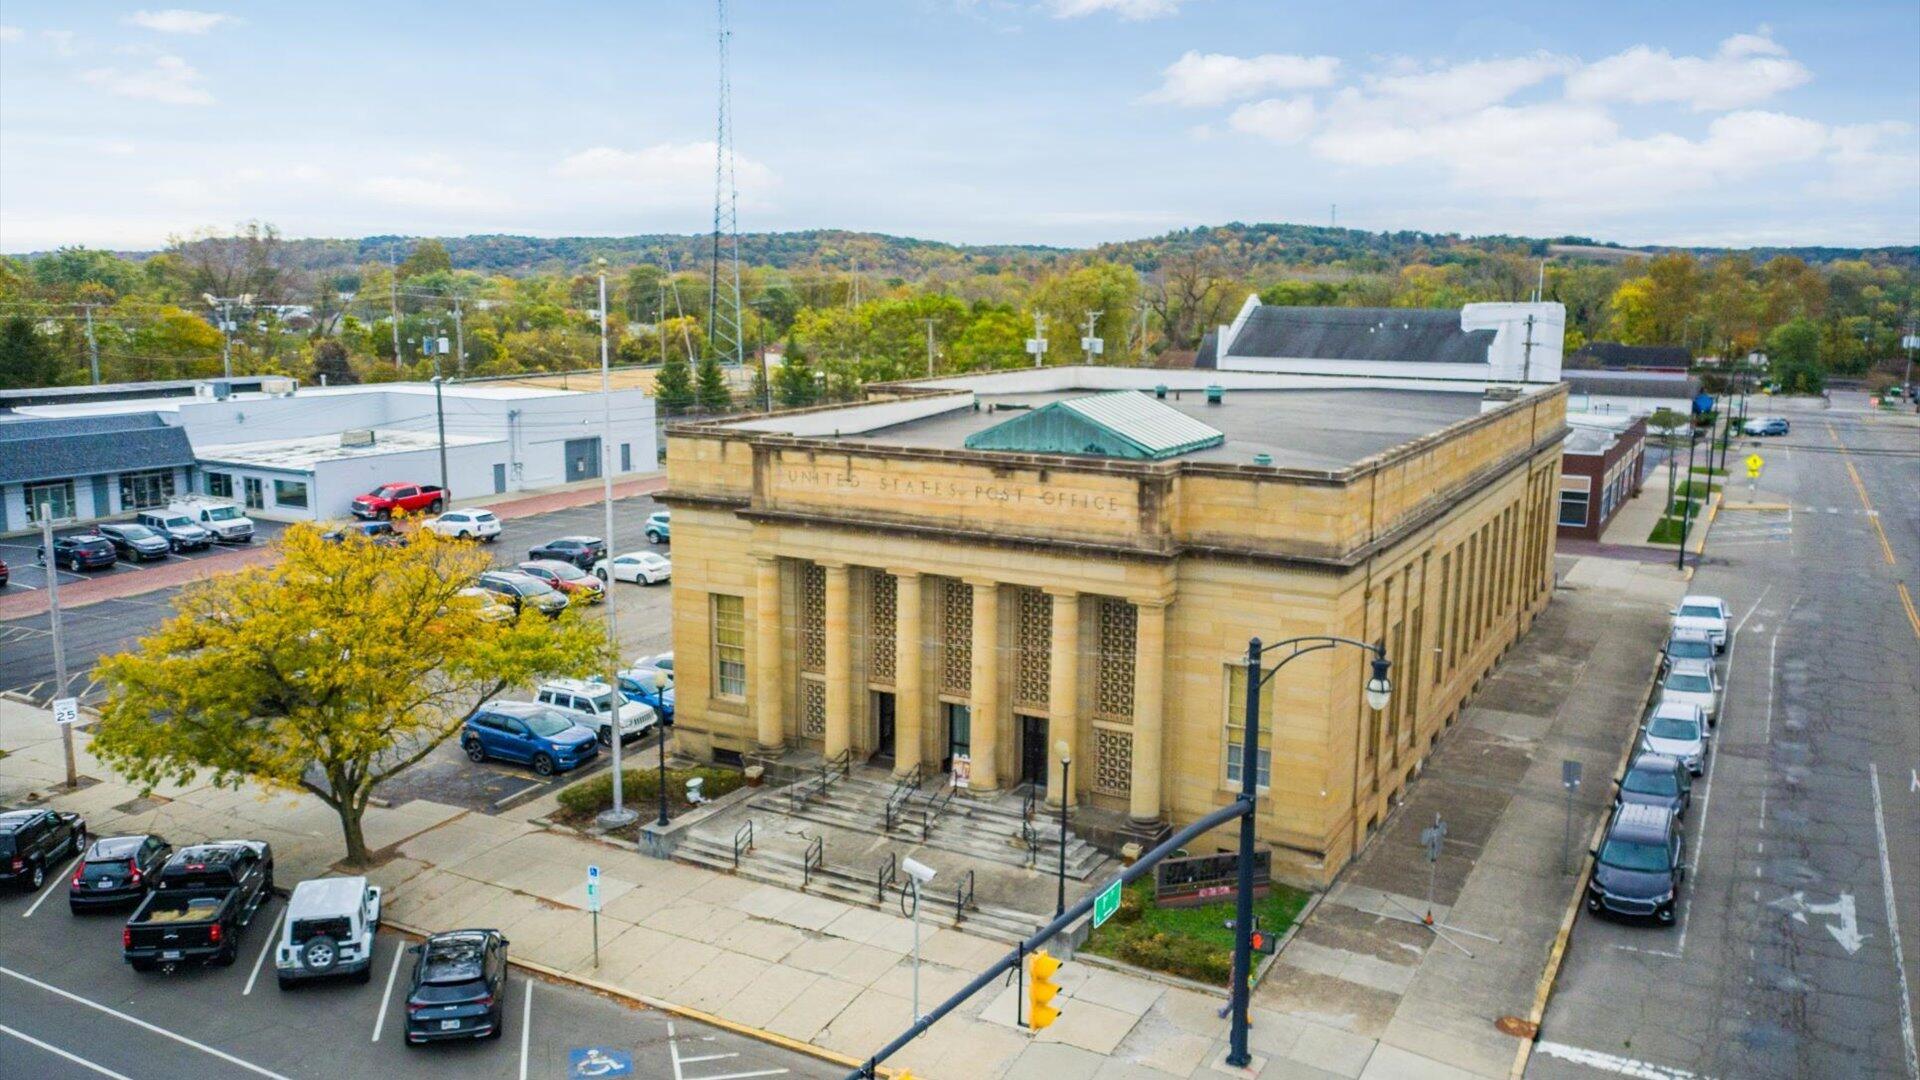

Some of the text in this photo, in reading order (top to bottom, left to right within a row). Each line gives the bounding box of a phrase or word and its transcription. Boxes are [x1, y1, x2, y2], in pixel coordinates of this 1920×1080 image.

[788, 470, 1118, 511] UNITED STATES POST OFFICE
[56, 710, 76, 722] 25
